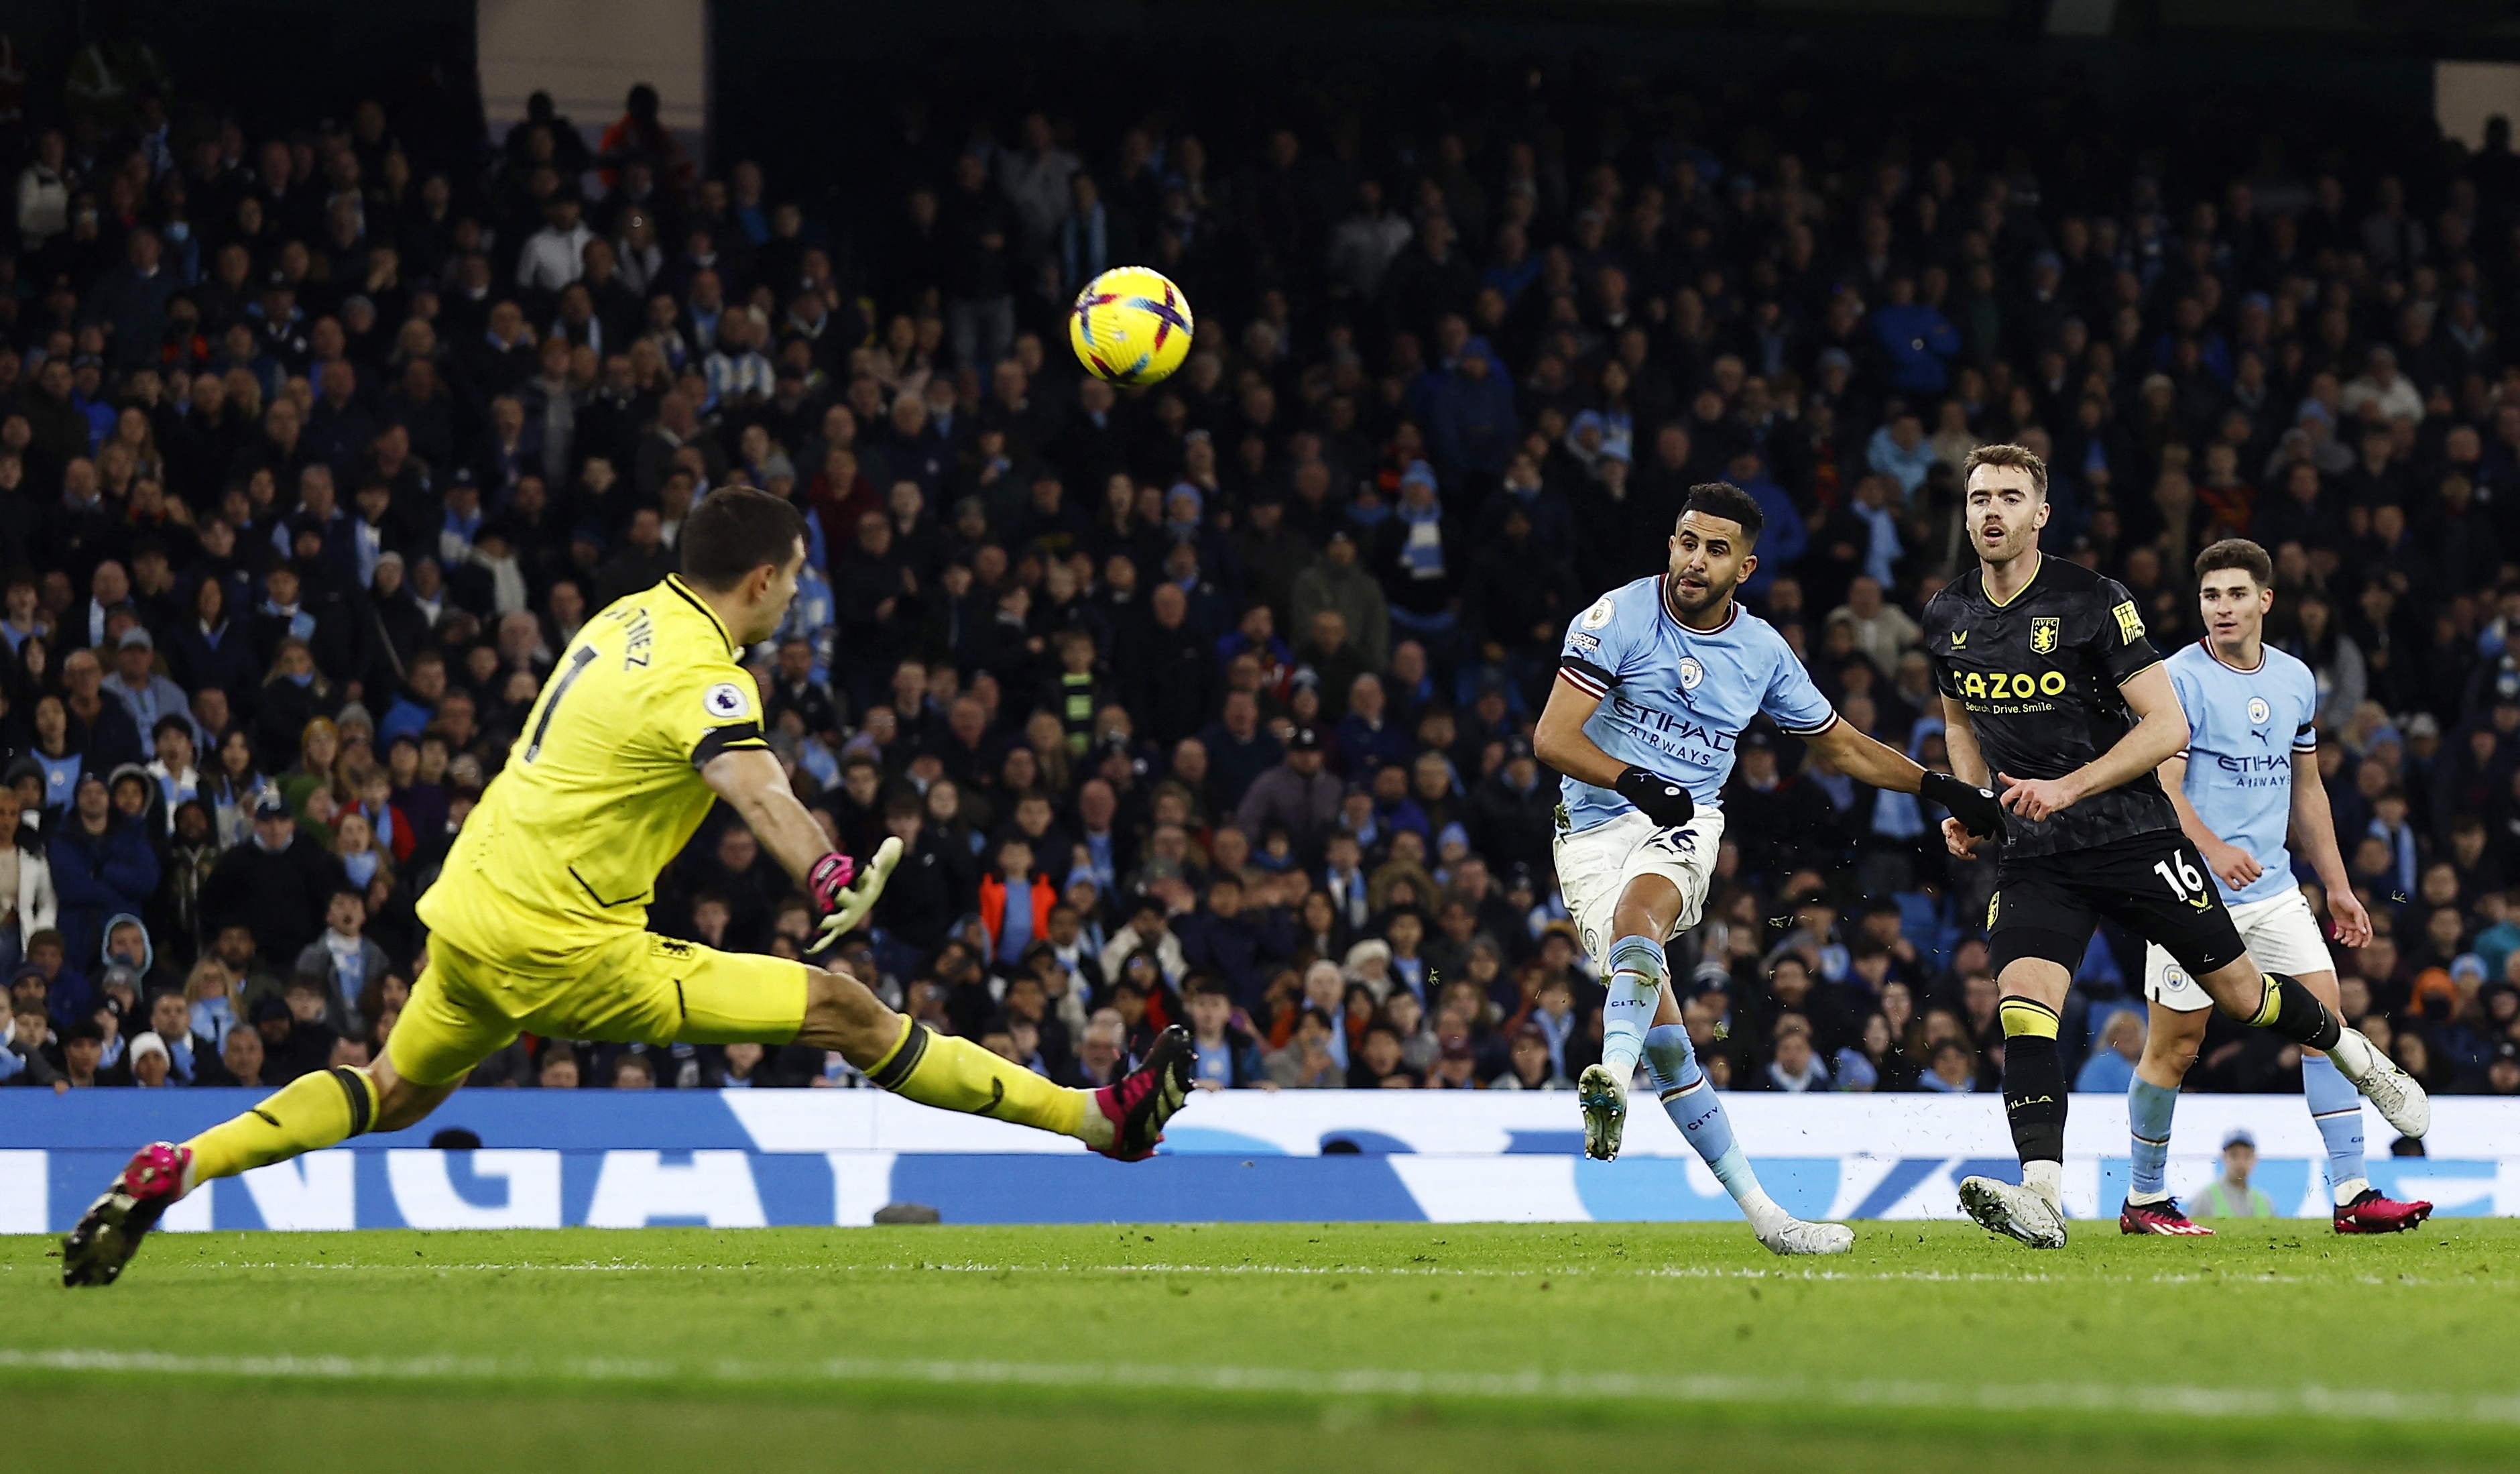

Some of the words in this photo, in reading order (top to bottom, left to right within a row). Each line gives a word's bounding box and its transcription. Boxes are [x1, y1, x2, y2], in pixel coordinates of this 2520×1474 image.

[2034, 619, 2057, 627] AVFC
[524, 642, 599, 764] 1
[1993, 704, 2021, 714] Drive.
[2023, 701, 2056, 713] Smile.
[1612, 696, 1738, 752] ETIHAD
[1628, 726, 1711, 766] AIRWAYS
[2217, 754, 2290, 773] ETIHA
[2153, 848, 2204, 903] 16
[1611, 999, 1646, 1008] CITY
[1687, 1106, 1718, 1131] CITY
